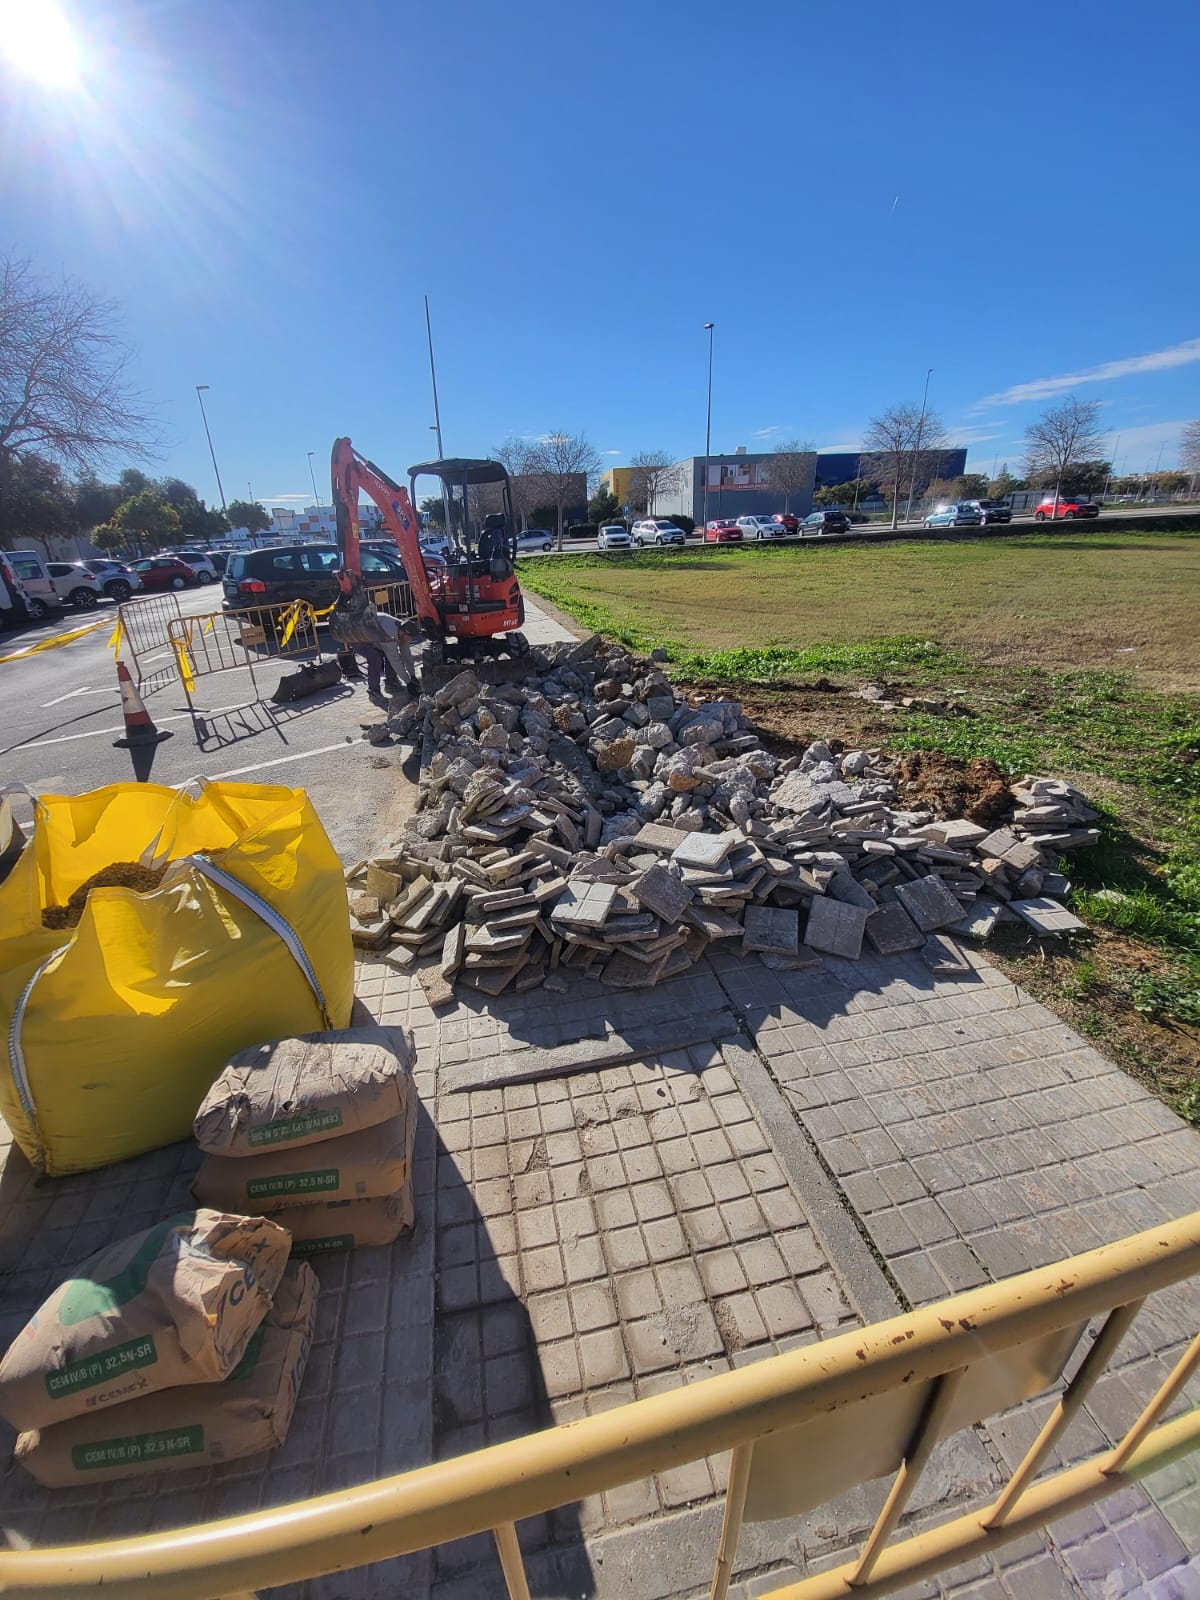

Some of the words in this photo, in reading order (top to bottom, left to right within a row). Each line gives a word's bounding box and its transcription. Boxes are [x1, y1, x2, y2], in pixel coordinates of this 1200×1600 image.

[321, 1113, 338, 1127] CEM
[250, 1183, 268, 1193] CEM
[284, 1179, 296, 1189] (P)
[49, 1374, 69, 1390] CEM
[88, 1362, 103, 1378] (P)
[84, 1449, 106, 1463] CEM
[127, 1444, 141, 1457] (P)
